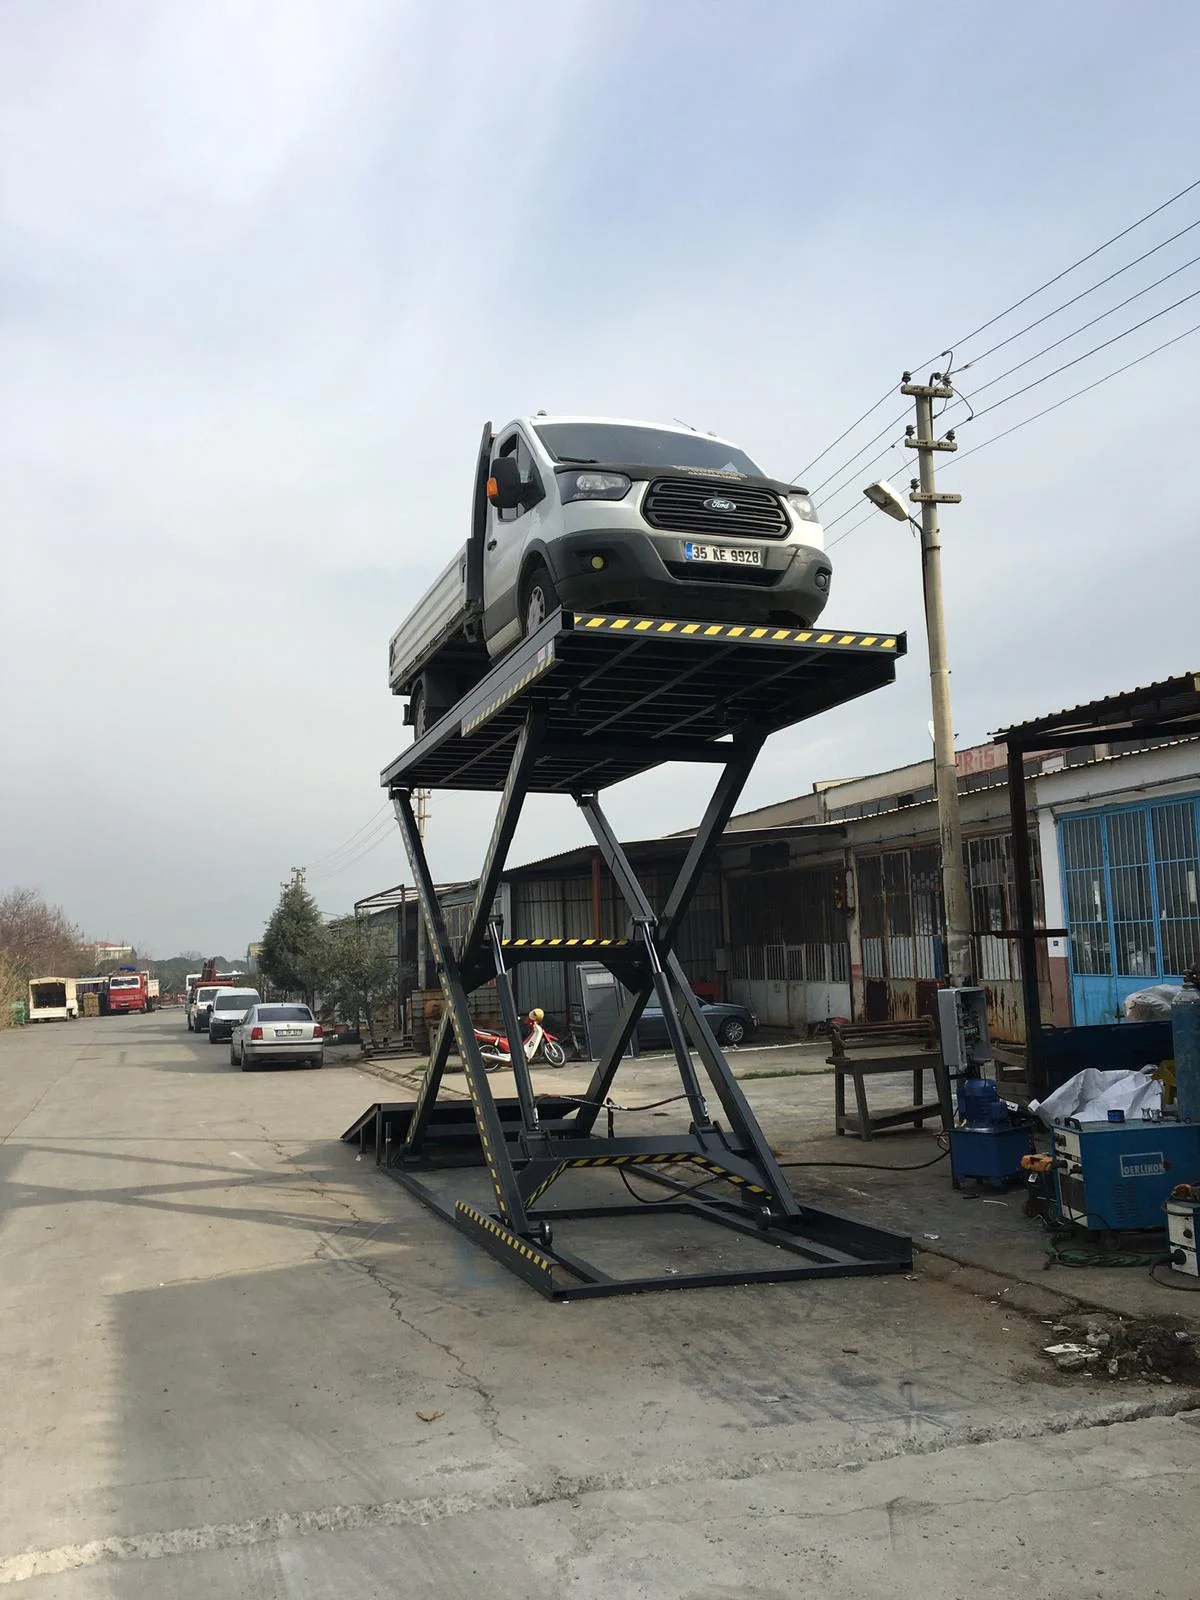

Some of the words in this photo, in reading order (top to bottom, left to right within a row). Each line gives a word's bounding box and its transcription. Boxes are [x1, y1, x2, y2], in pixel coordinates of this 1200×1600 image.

[711, 500, 730, 509] Ford
[693, 546, 708, 559] 35
[730, 550, 759, 563] 9928
